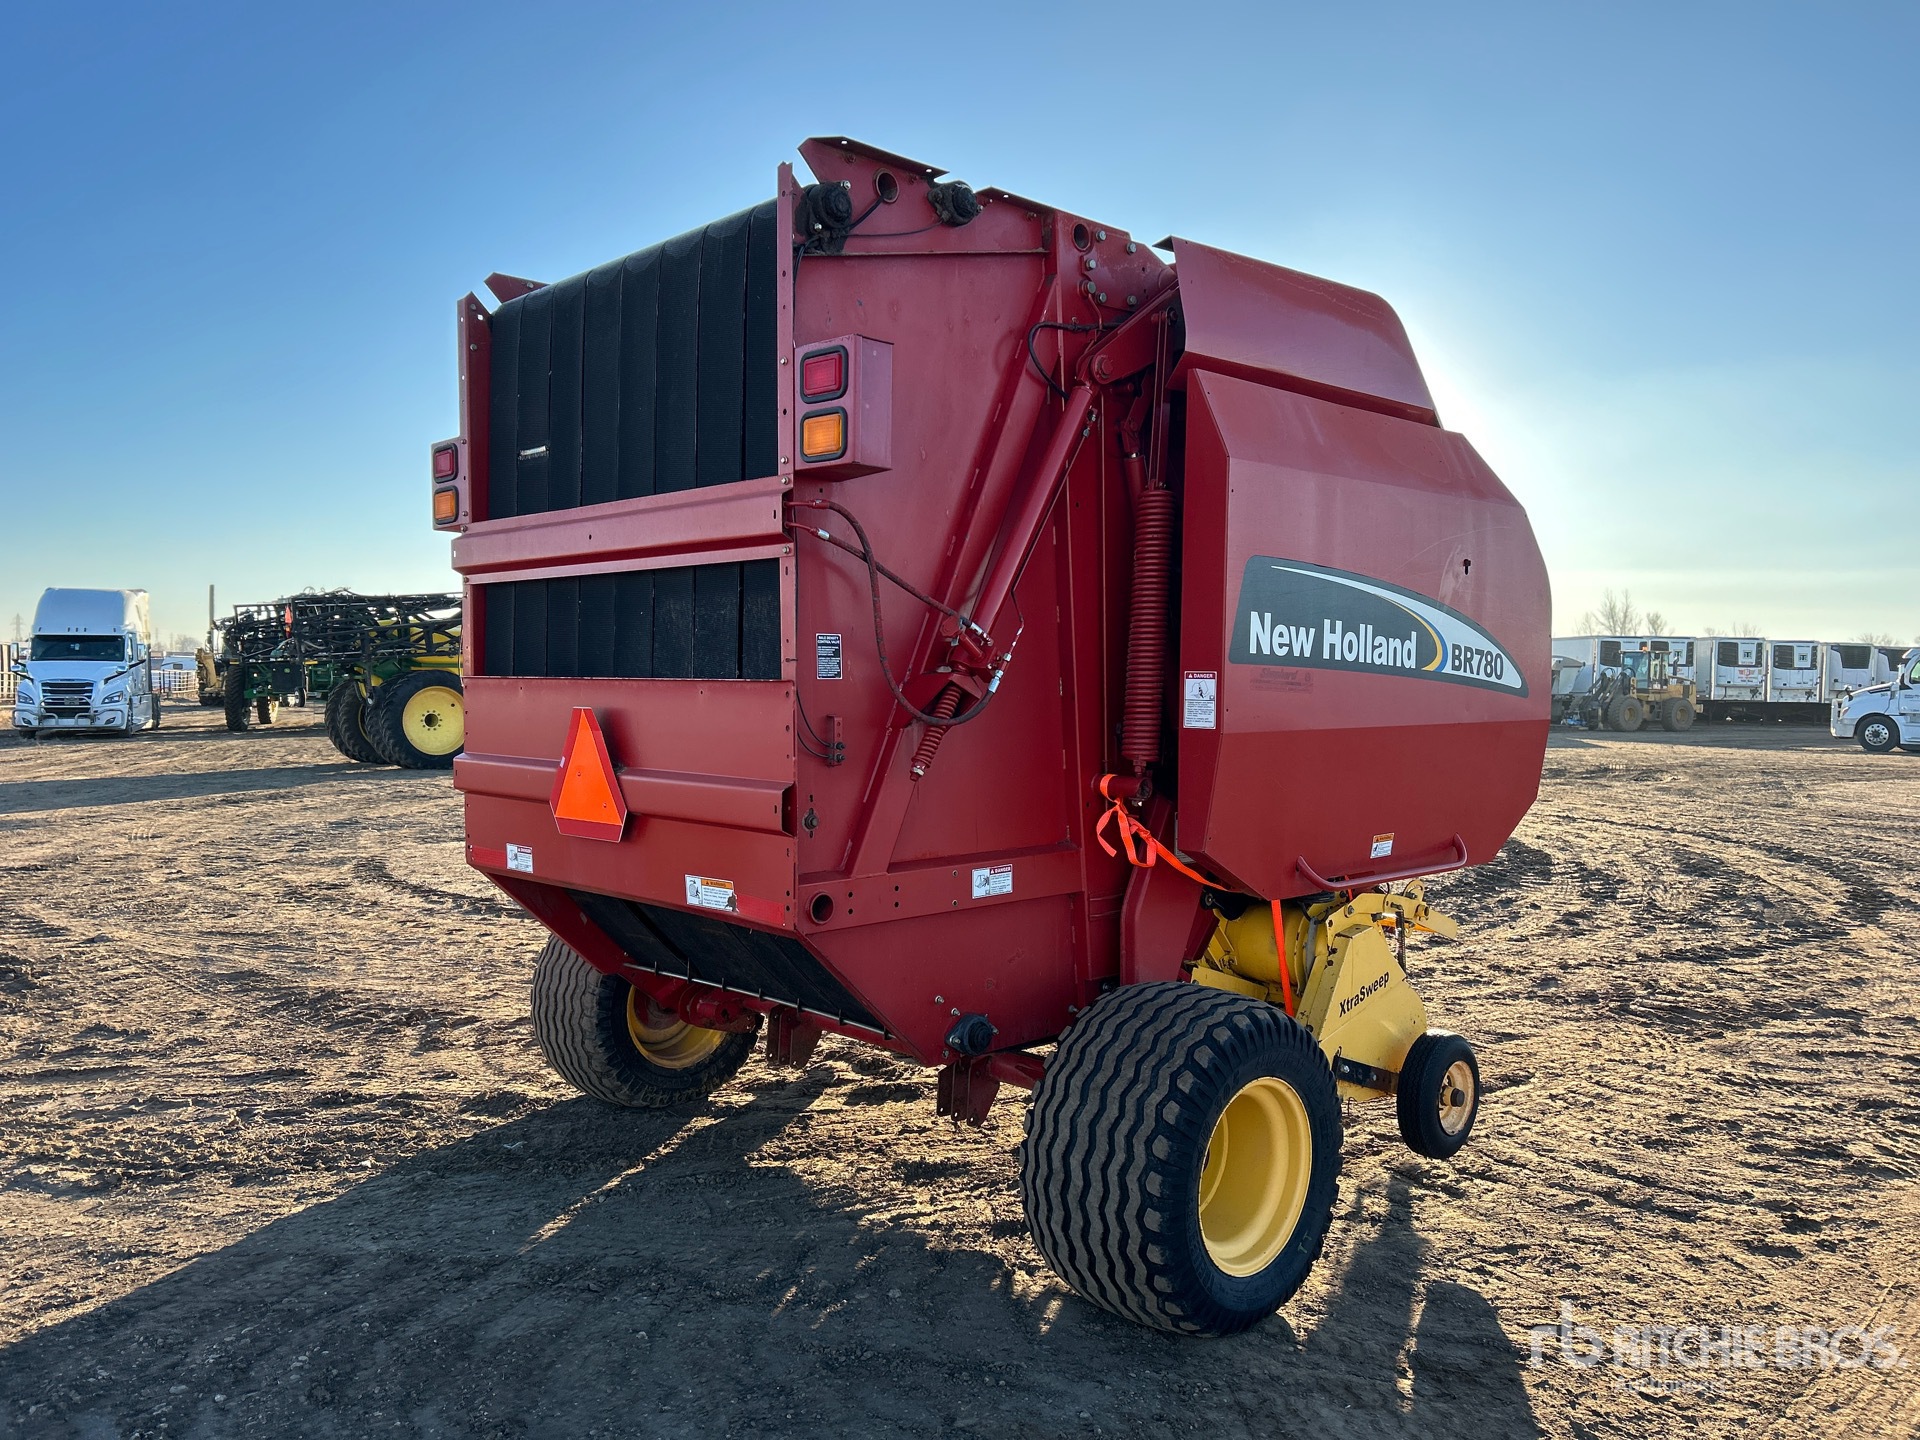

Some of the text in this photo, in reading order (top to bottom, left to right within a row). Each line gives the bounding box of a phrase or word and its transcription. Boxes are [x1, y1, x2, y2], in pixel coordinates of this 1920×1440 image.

[1249, 611, 1417, 669] New Holland
[1451, 643, 1504, 681] BR780
[1339, 971, 1390, 1018] XtraSweep
